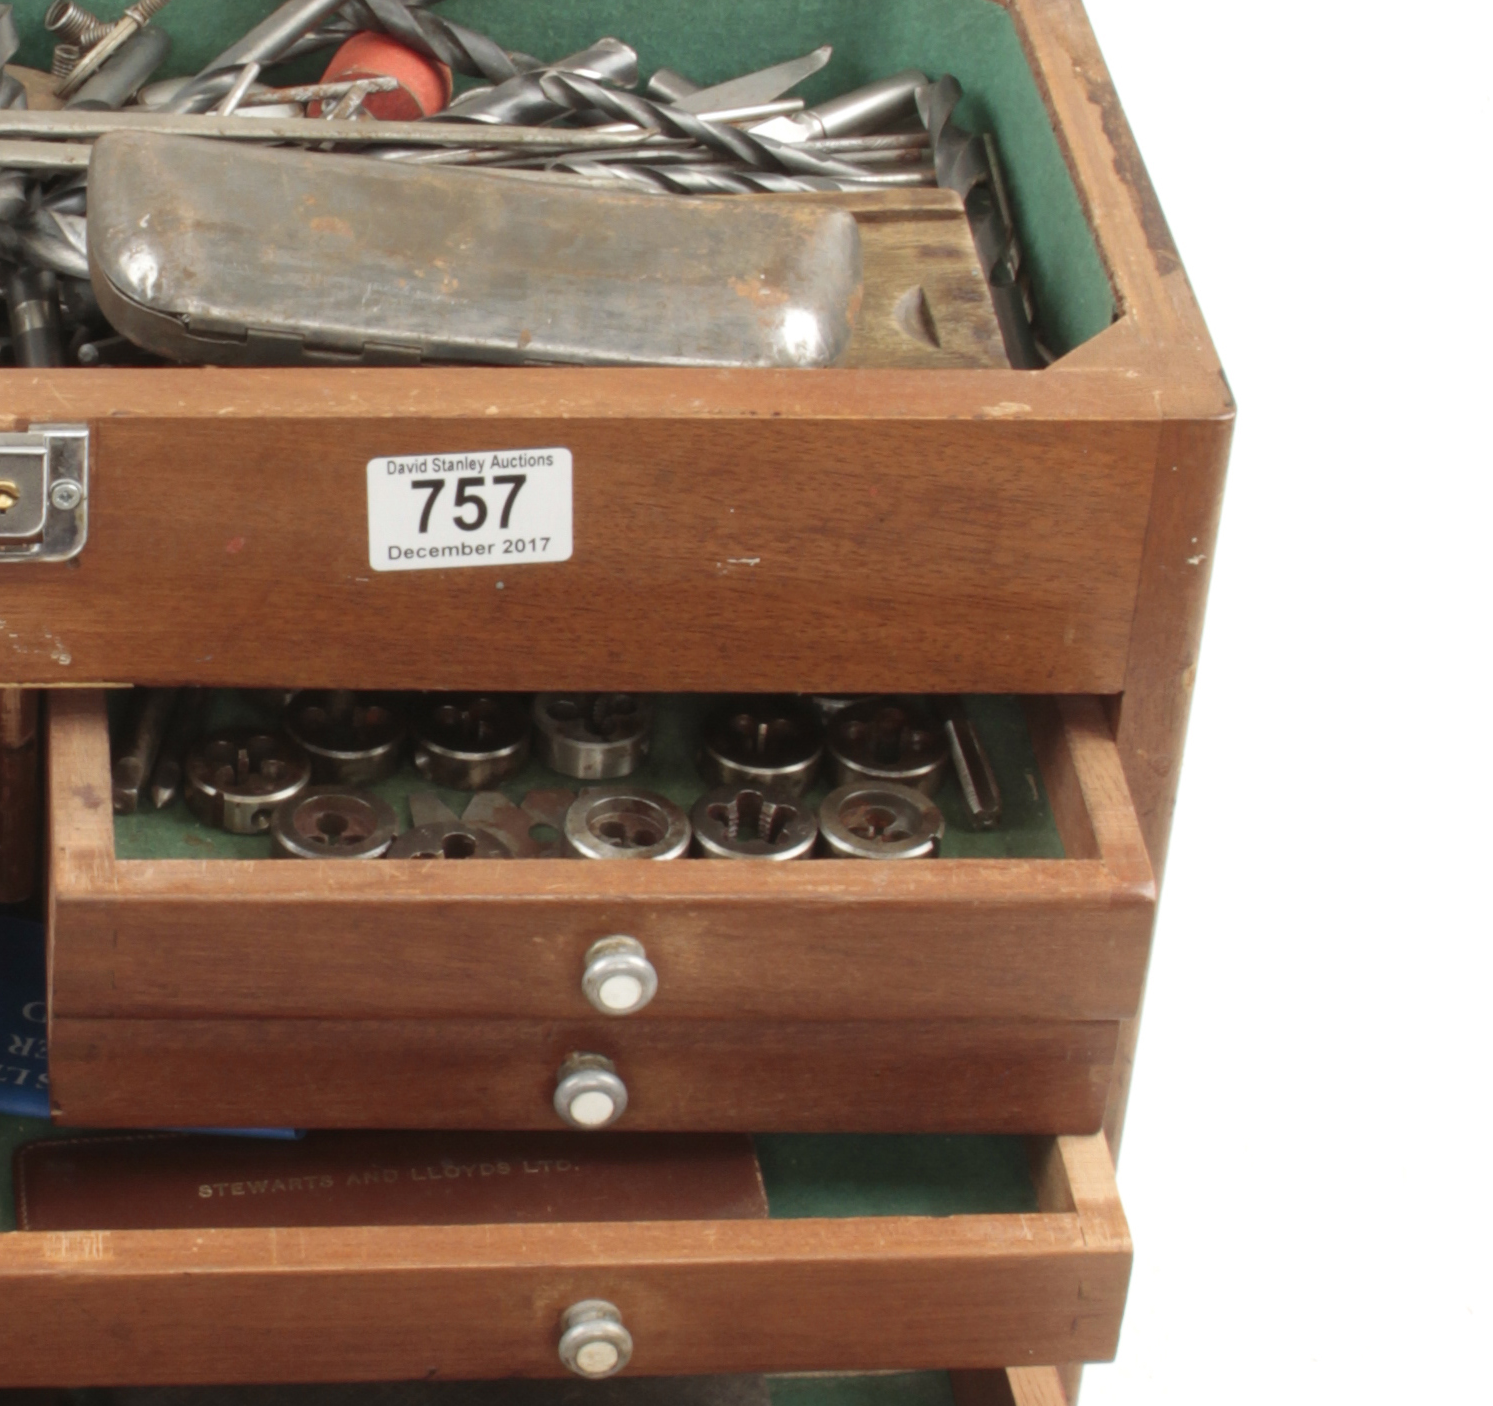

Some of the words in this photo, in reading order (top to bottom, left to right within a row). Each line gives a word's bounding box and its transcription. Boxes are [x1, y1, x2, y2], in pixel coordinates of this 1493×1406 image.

[386, 458, 427, 475] David
[431, 456, 486, 474] Stanley
[489, 453, 554, 470] Auctions
[411, 474, 527, 534] 757
[388, 541, 496, 560] December
[502, 536, 551, 554] 2017
[198, 1175, 334, 1198] STEWARTS
[347, 1169, 398, 1187] AND
[411, 1162, 511, 1181] LLOYDS
